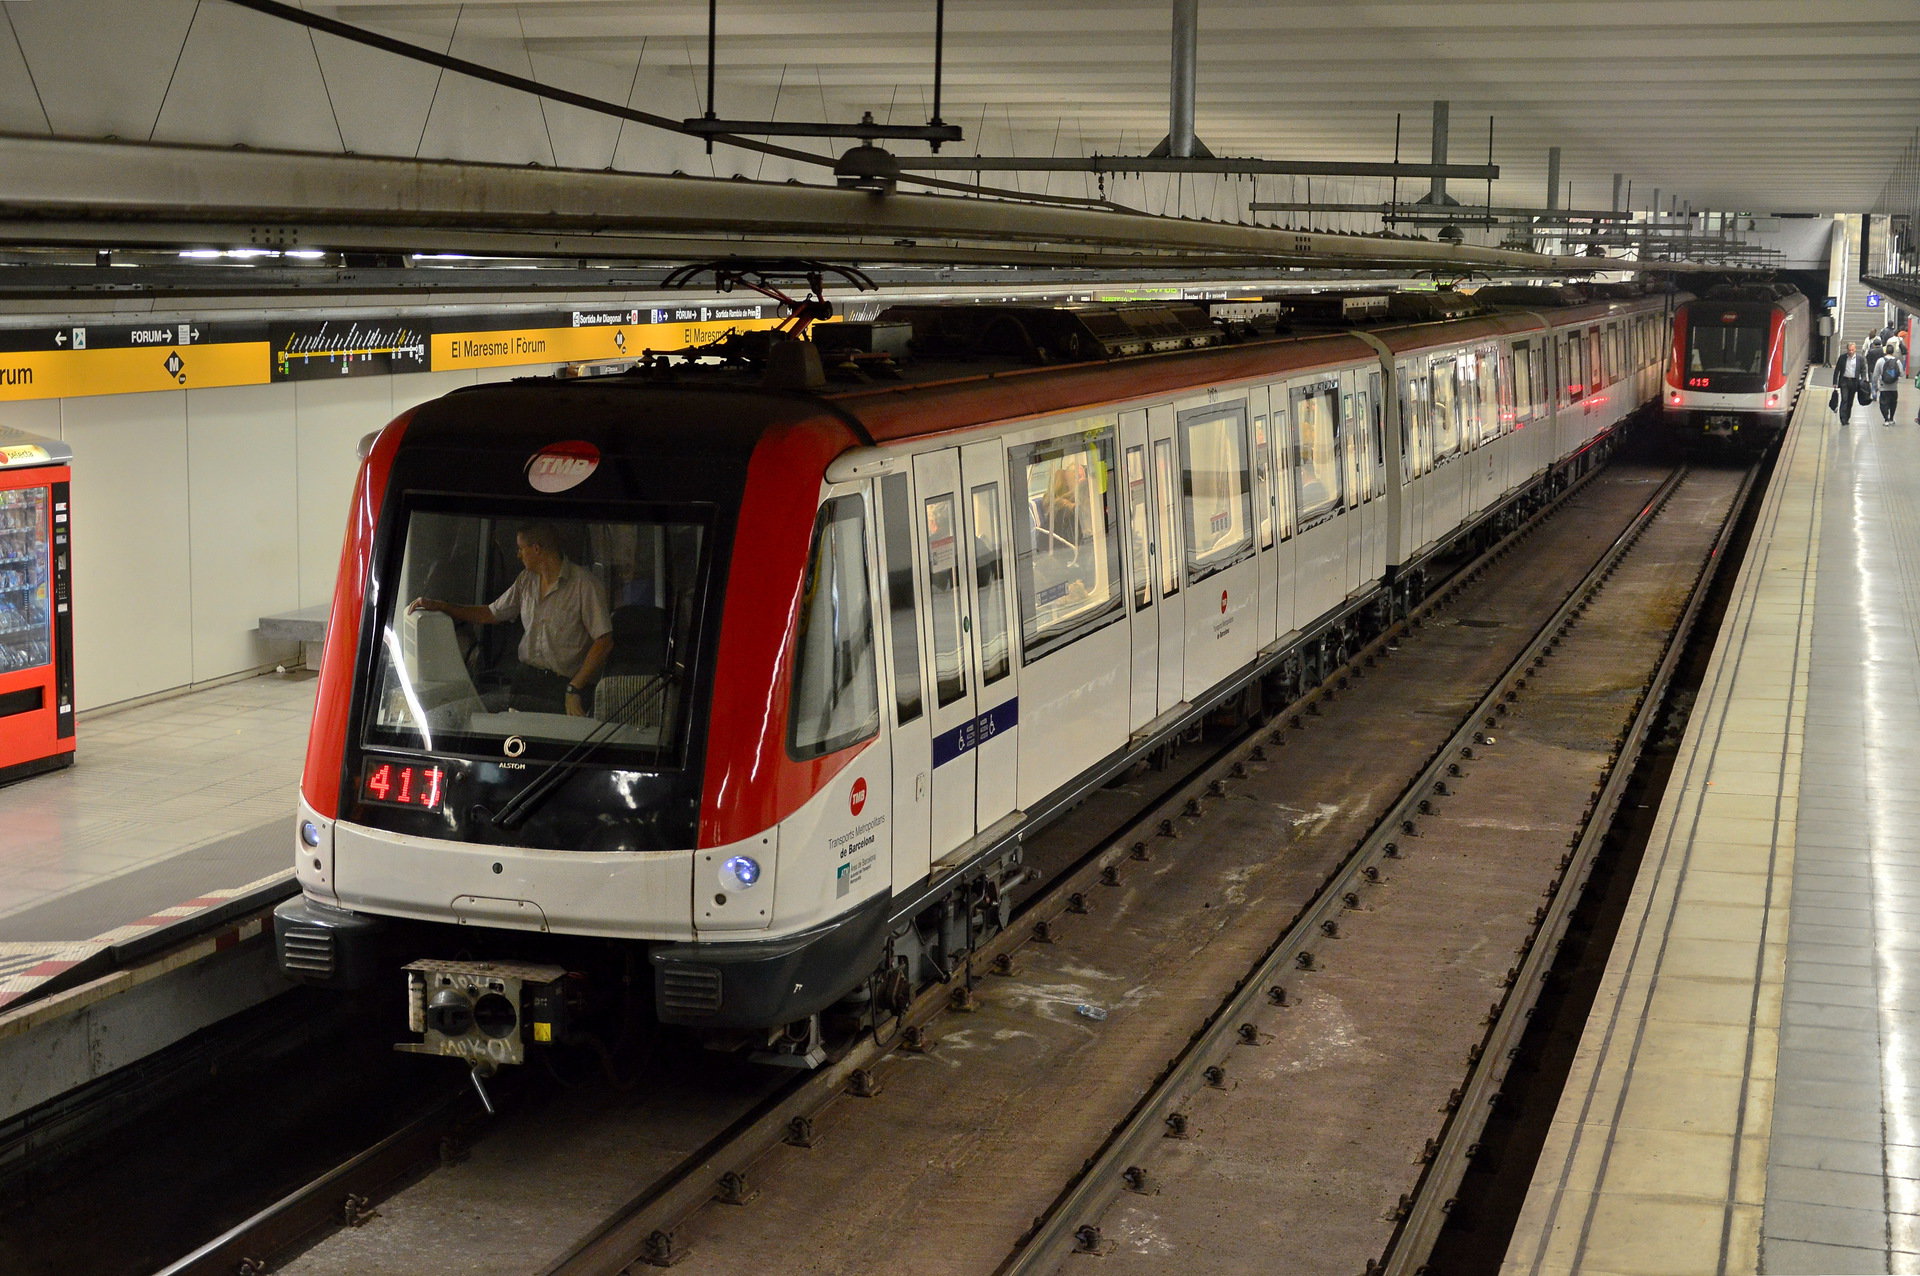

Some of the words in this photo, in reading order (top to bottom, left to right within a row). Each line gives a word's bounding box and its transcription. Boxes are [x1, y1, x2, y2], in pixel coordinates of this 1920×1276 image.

[579, 314, 596, 324] Sortida
[602, 313, 622, 325] Diagonal
[715, 309, 729, 318] Sortida
[684, 328, 692, 343] El
[451, 340, 461, 358] El
[463, 340, 508, 357] Maresme
[516, 337, 546, 354] Fòrum
[499, 762, 526, 770] ALSTOM
[828, 829, 855, 850] Transports
[855, 815, 886, 836] Metropolitans
[840, 847, 847, 859] de
[848, 834, 875, 855] Barcelona
